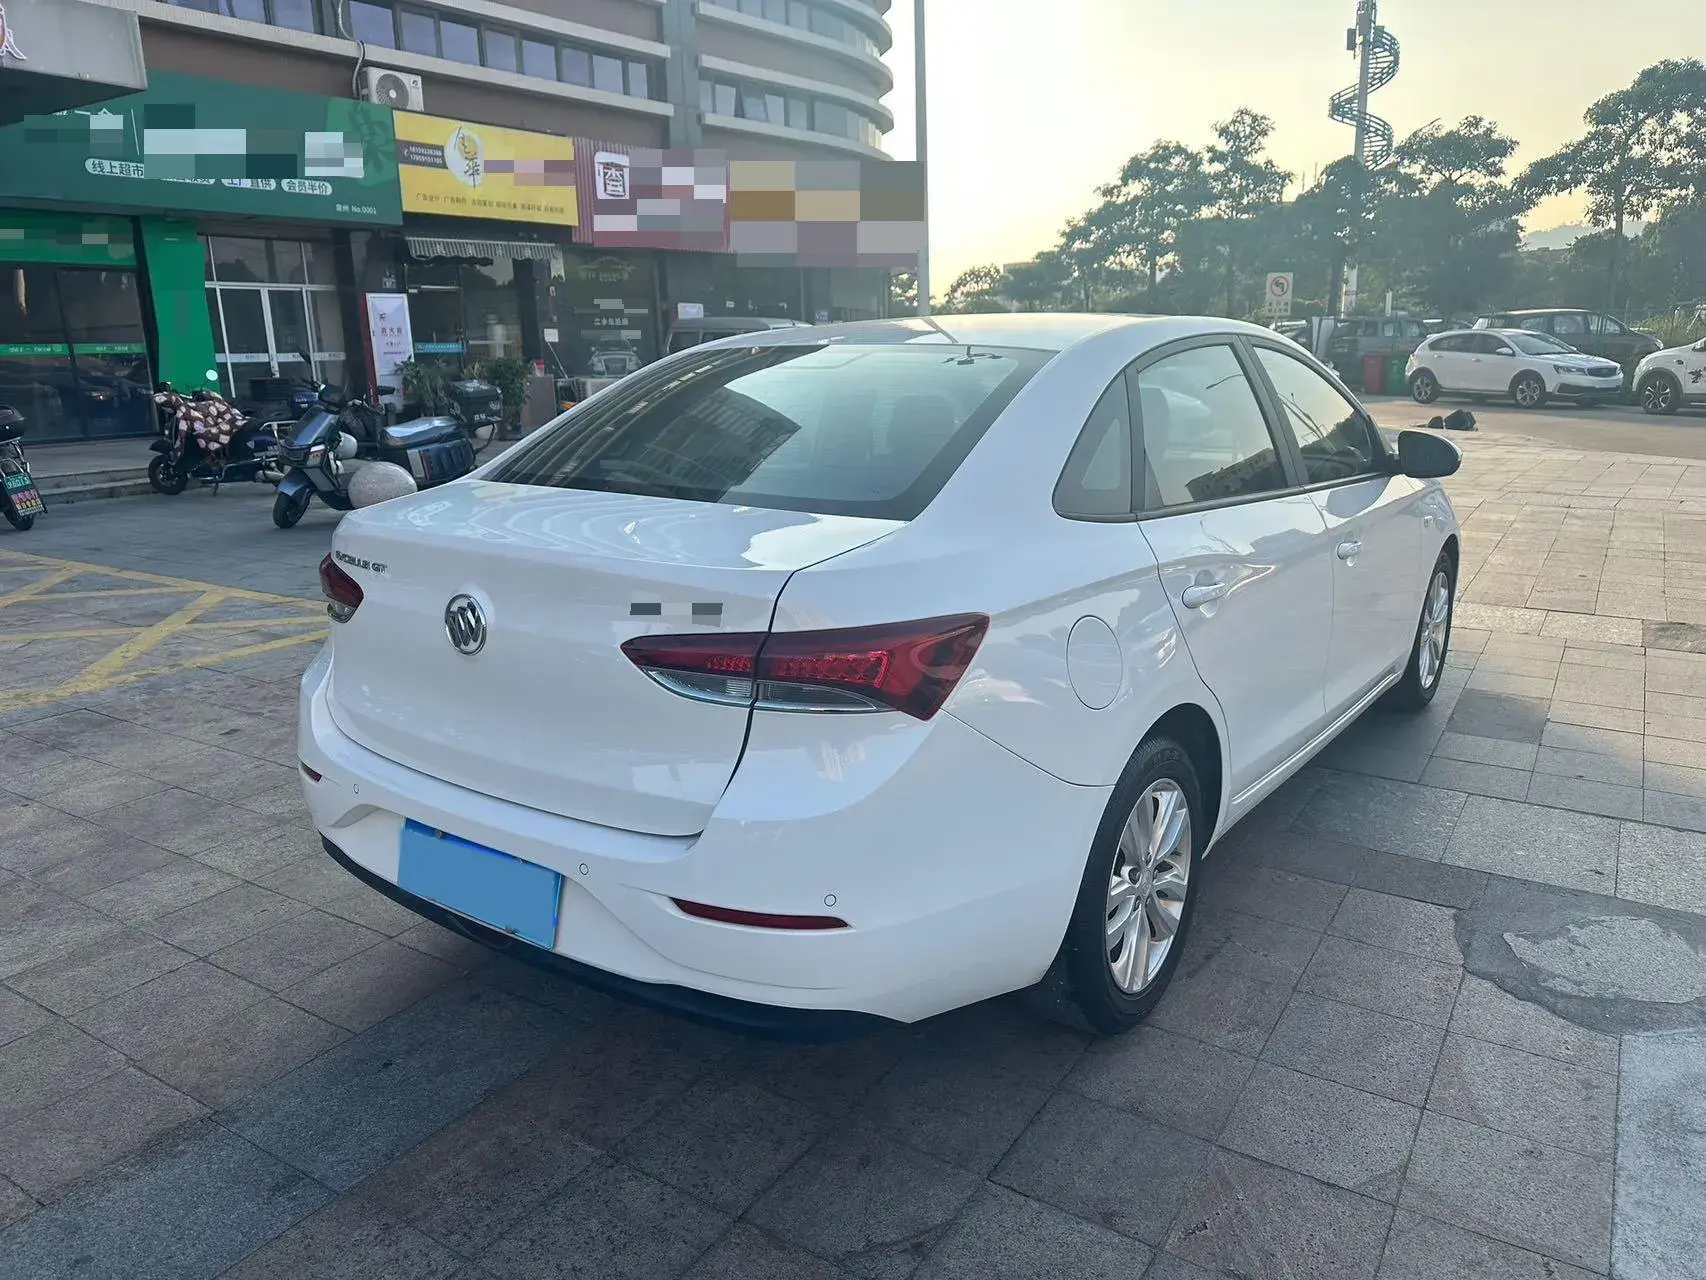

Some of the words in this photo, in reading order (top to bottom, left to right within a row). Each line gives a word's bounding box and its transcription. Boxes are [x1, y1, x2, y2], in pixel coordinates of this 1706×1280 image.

[91, 160, 144, 177] 线上超市
[286, 180, 329, 195] 会员半价
[351, 205, 377, 215] No.0001
